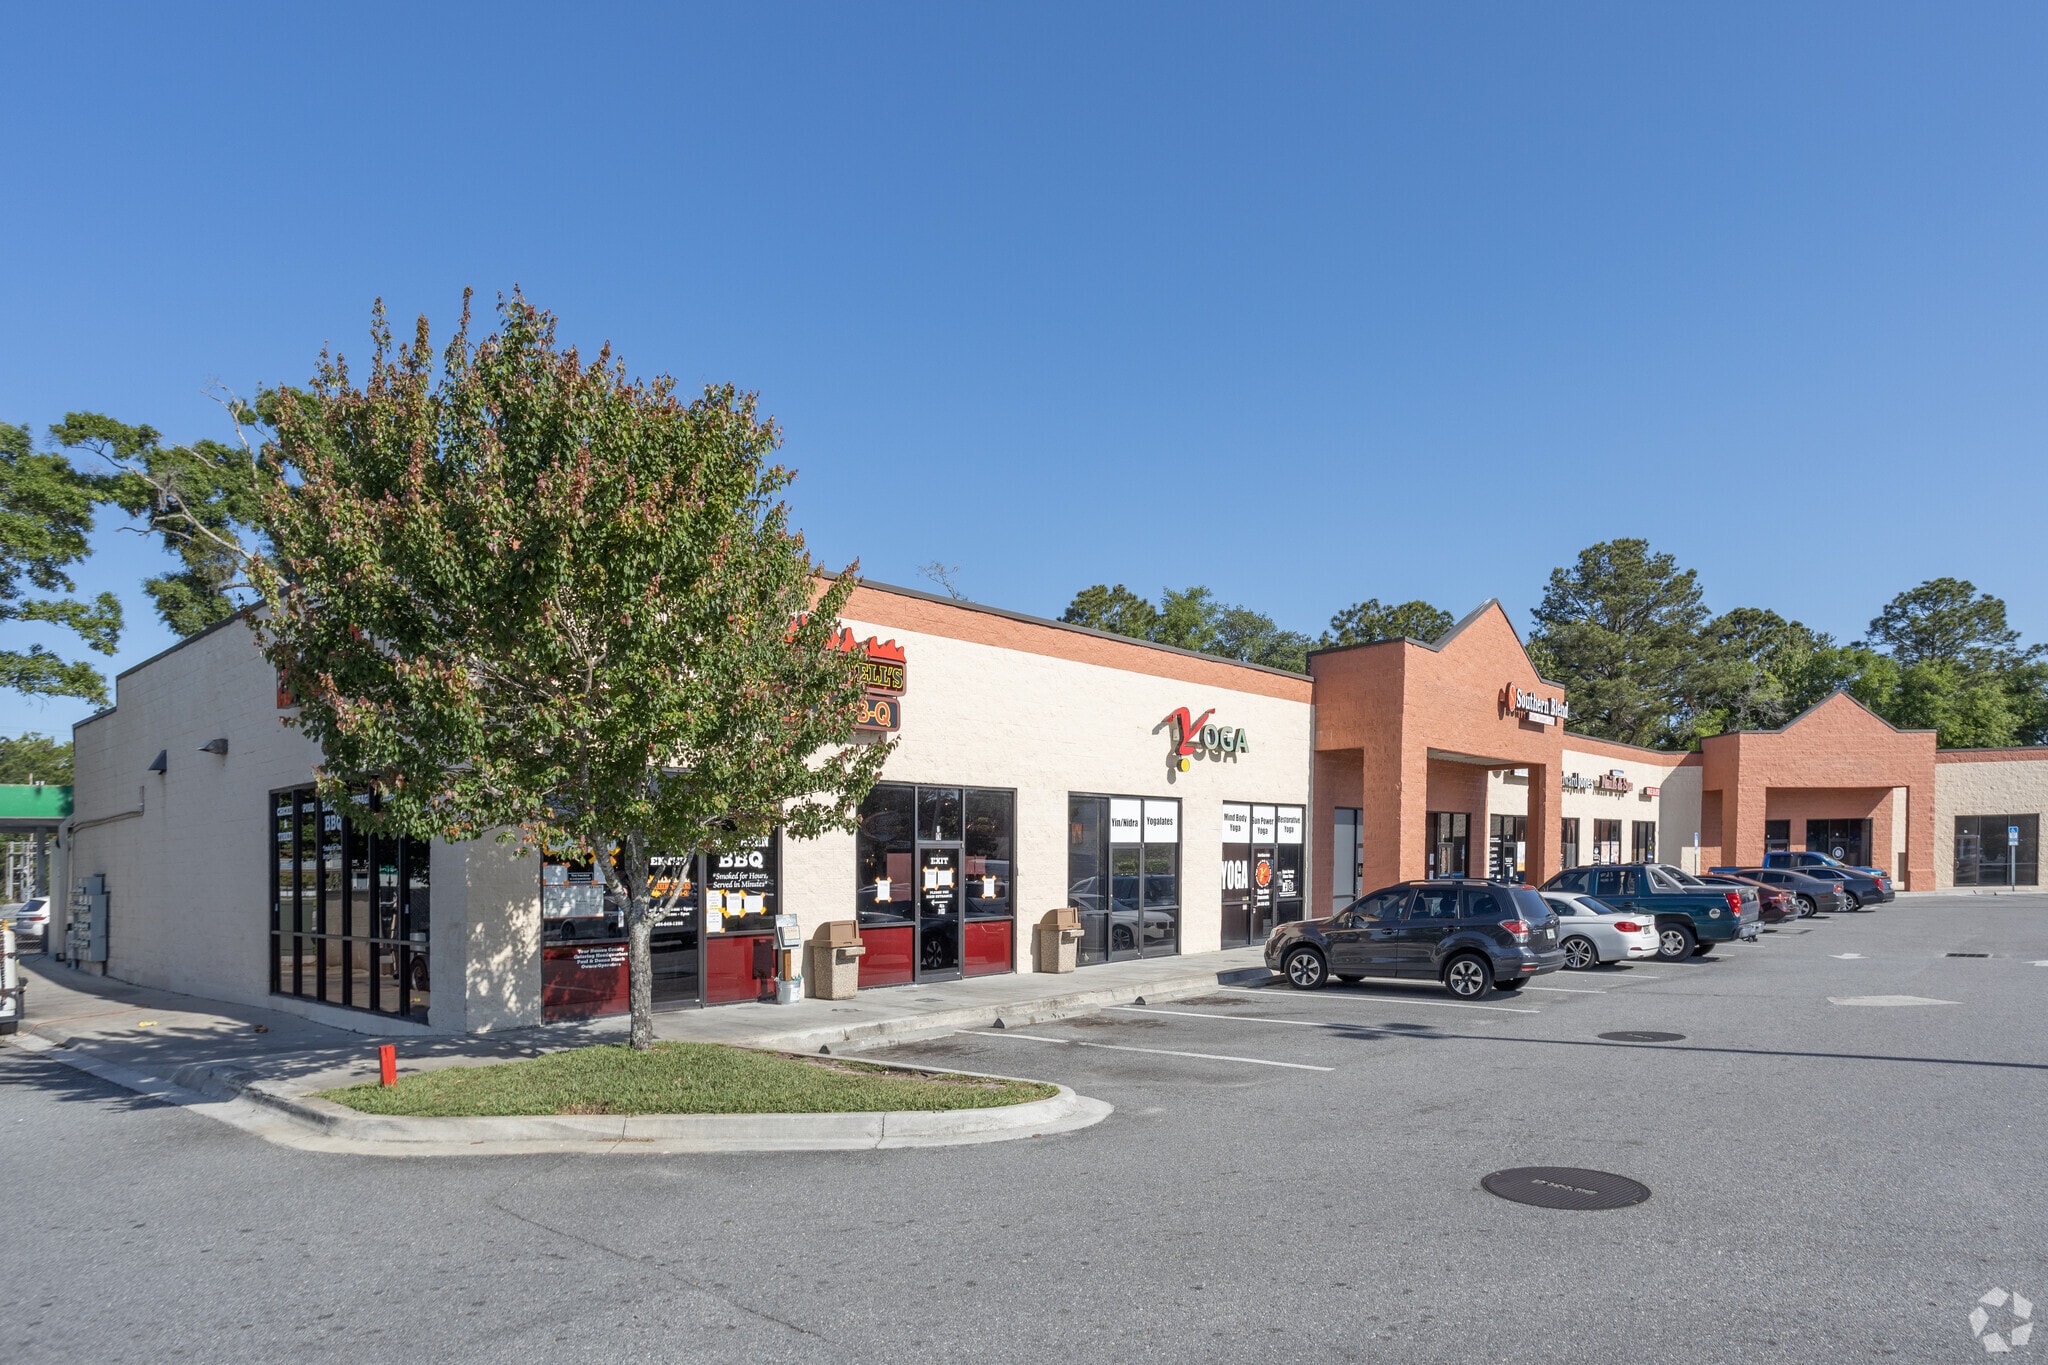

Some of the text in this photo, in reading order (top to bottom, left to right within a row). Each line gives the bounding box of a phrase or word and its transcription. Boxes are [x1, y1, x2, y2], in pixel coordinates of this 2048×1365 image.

[855, 662, 903, 688] ELL'S
[1517, 688, 1569, 718] Southern Blend
[1166, 707, 1249, 756] YOGA
[1147, 817, 1173, 826] Yogalates
[1224, 813, 1247, 823] Mind Body
[1278, 816, 1300, 824] Restorative
[1230, 824, 1241, 832] Yoga
[1258, 827, 1268, 835] Yoga
[1284, 826, 1294, 834] Yoga
[719, 851, 763, 868] BBQ
[739, 872, 748, 881] for
[1221, 860, 1248, 890] YOGA
